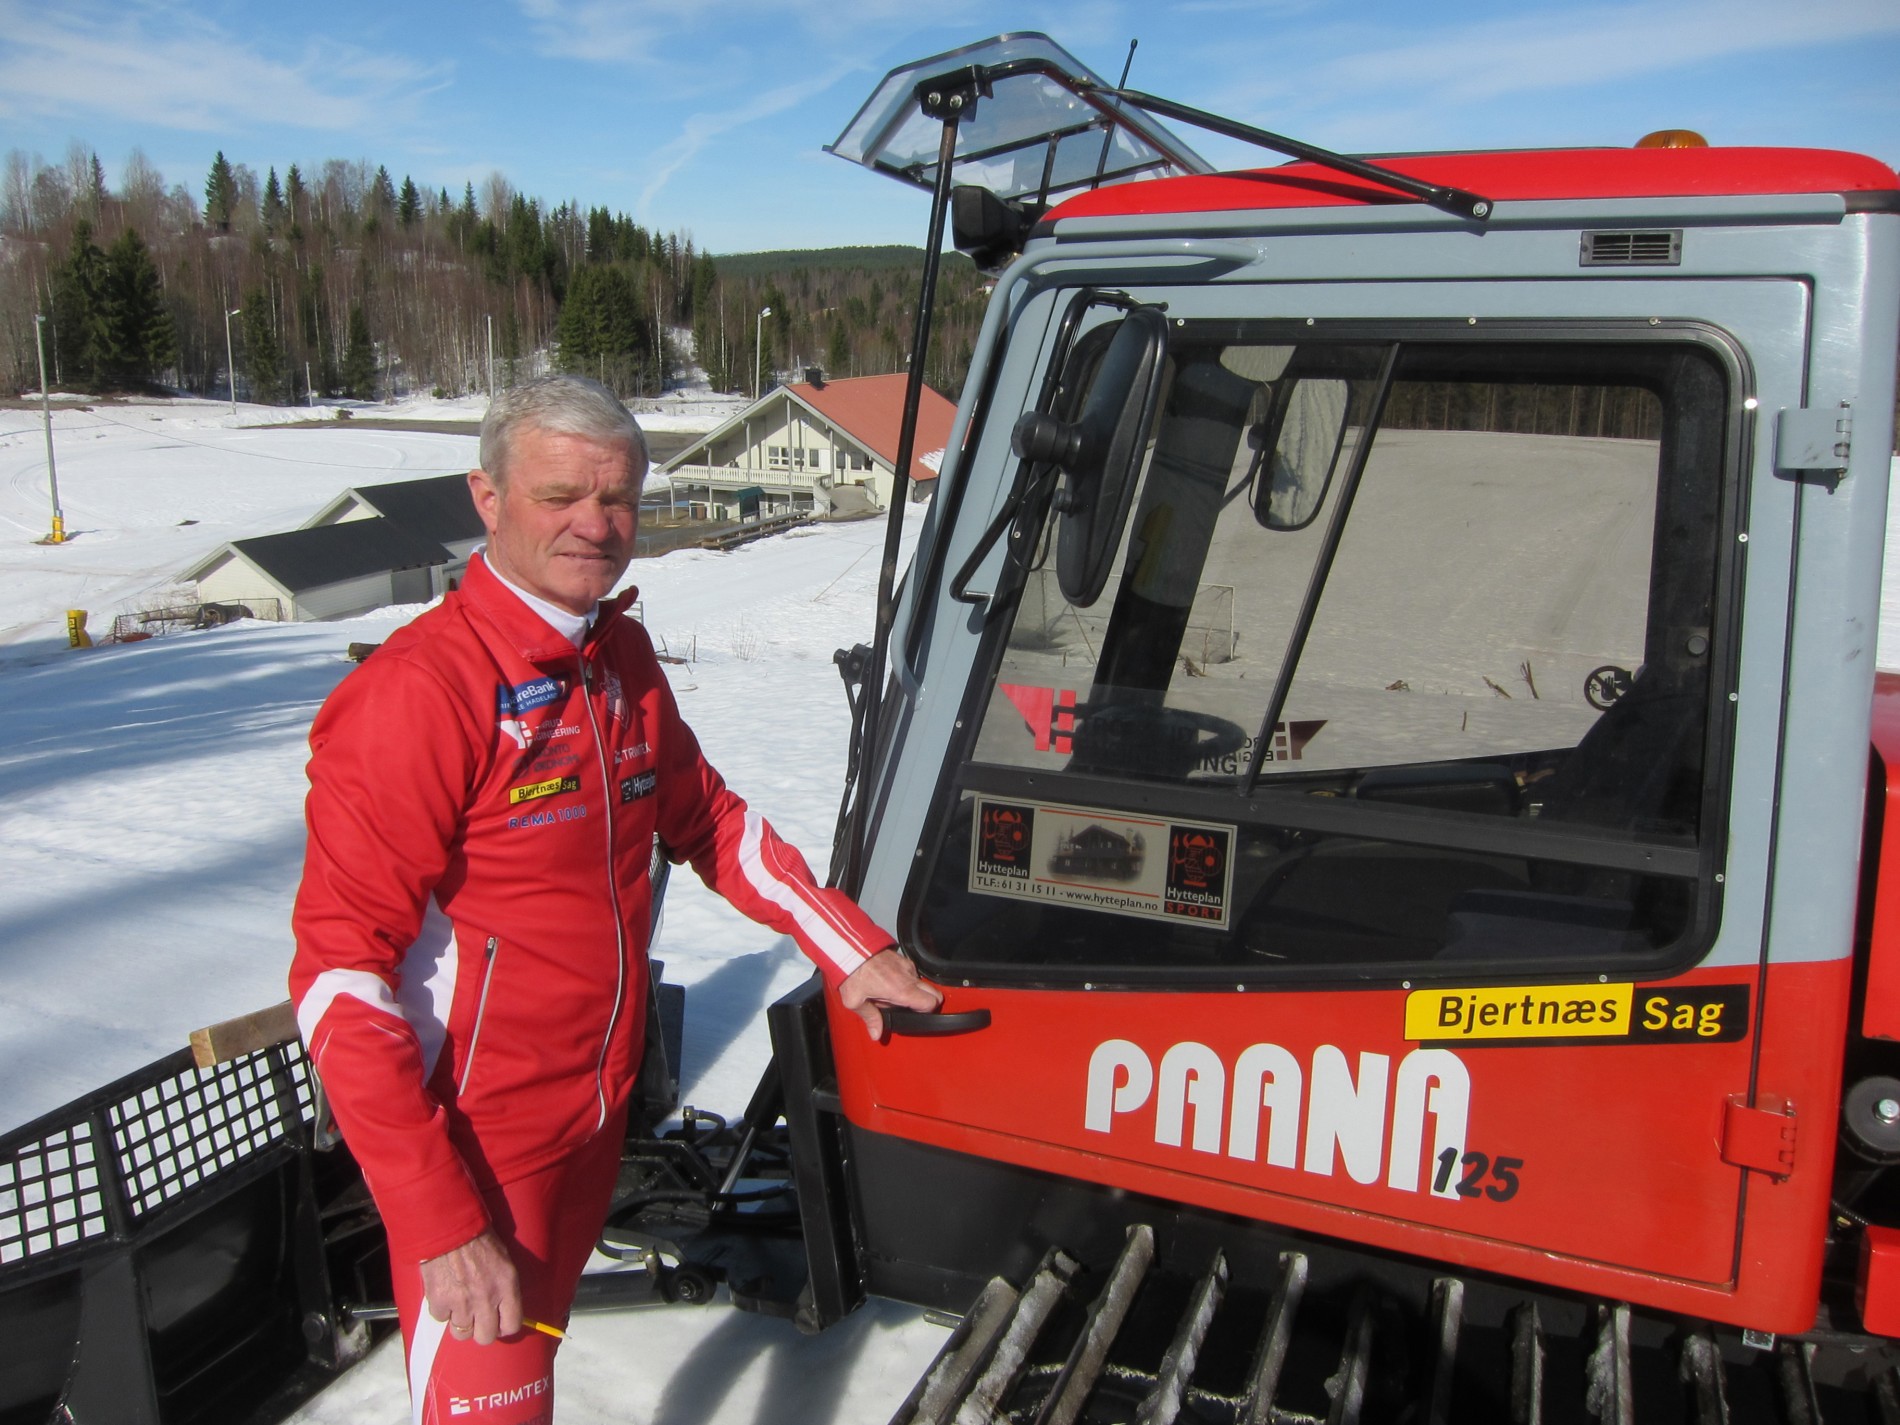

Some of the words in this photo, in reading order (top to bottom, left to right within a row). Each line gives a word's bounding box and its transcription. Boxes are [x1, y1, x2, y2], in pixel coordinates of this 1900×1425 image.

[562, 780, 577, 791] Sag
[509, 811, 555, 828] REMA
[558, 804, 586, 821] 1000
[978, 860, 1028, 877] Hytteplan
[1066, 891, 1158, 911] www.hytteplan.no
[1167, 886, 1221, 905] Hytteplan
[1167, 902, 1222, 919] SPORT
[1437, 994, 1618, 1034] Bjertnæs
[1642, 997, 1725, 1036] Sag
[1084, 1038, 1471, 1200] PAANA
[1433, 1146, 1525, 1203] 125
[473, 1375, 550, 1411] TRIMTEX
